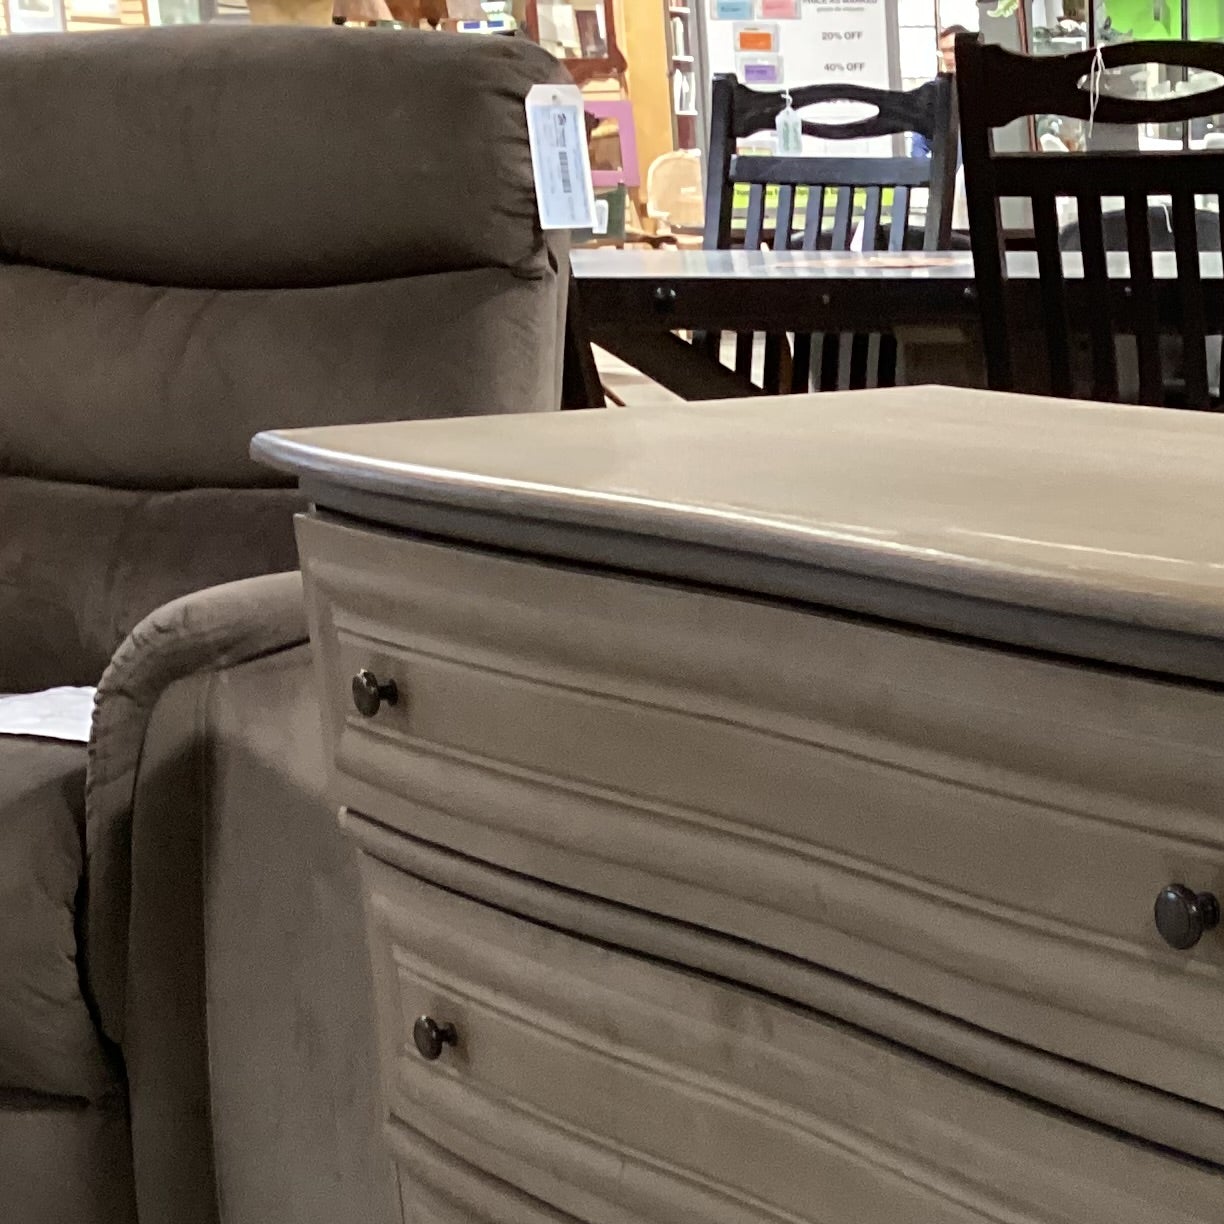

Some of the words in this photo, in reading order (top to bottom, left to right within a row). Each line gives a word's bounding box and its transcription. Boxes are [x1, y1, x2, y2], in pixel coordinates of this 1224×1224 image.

[821, 31, 842, 40] 20%
[844, 31, 863, 40] OFF
[824, 63, 845, 71] 40%
[846, 62, 865, 71] OFF
